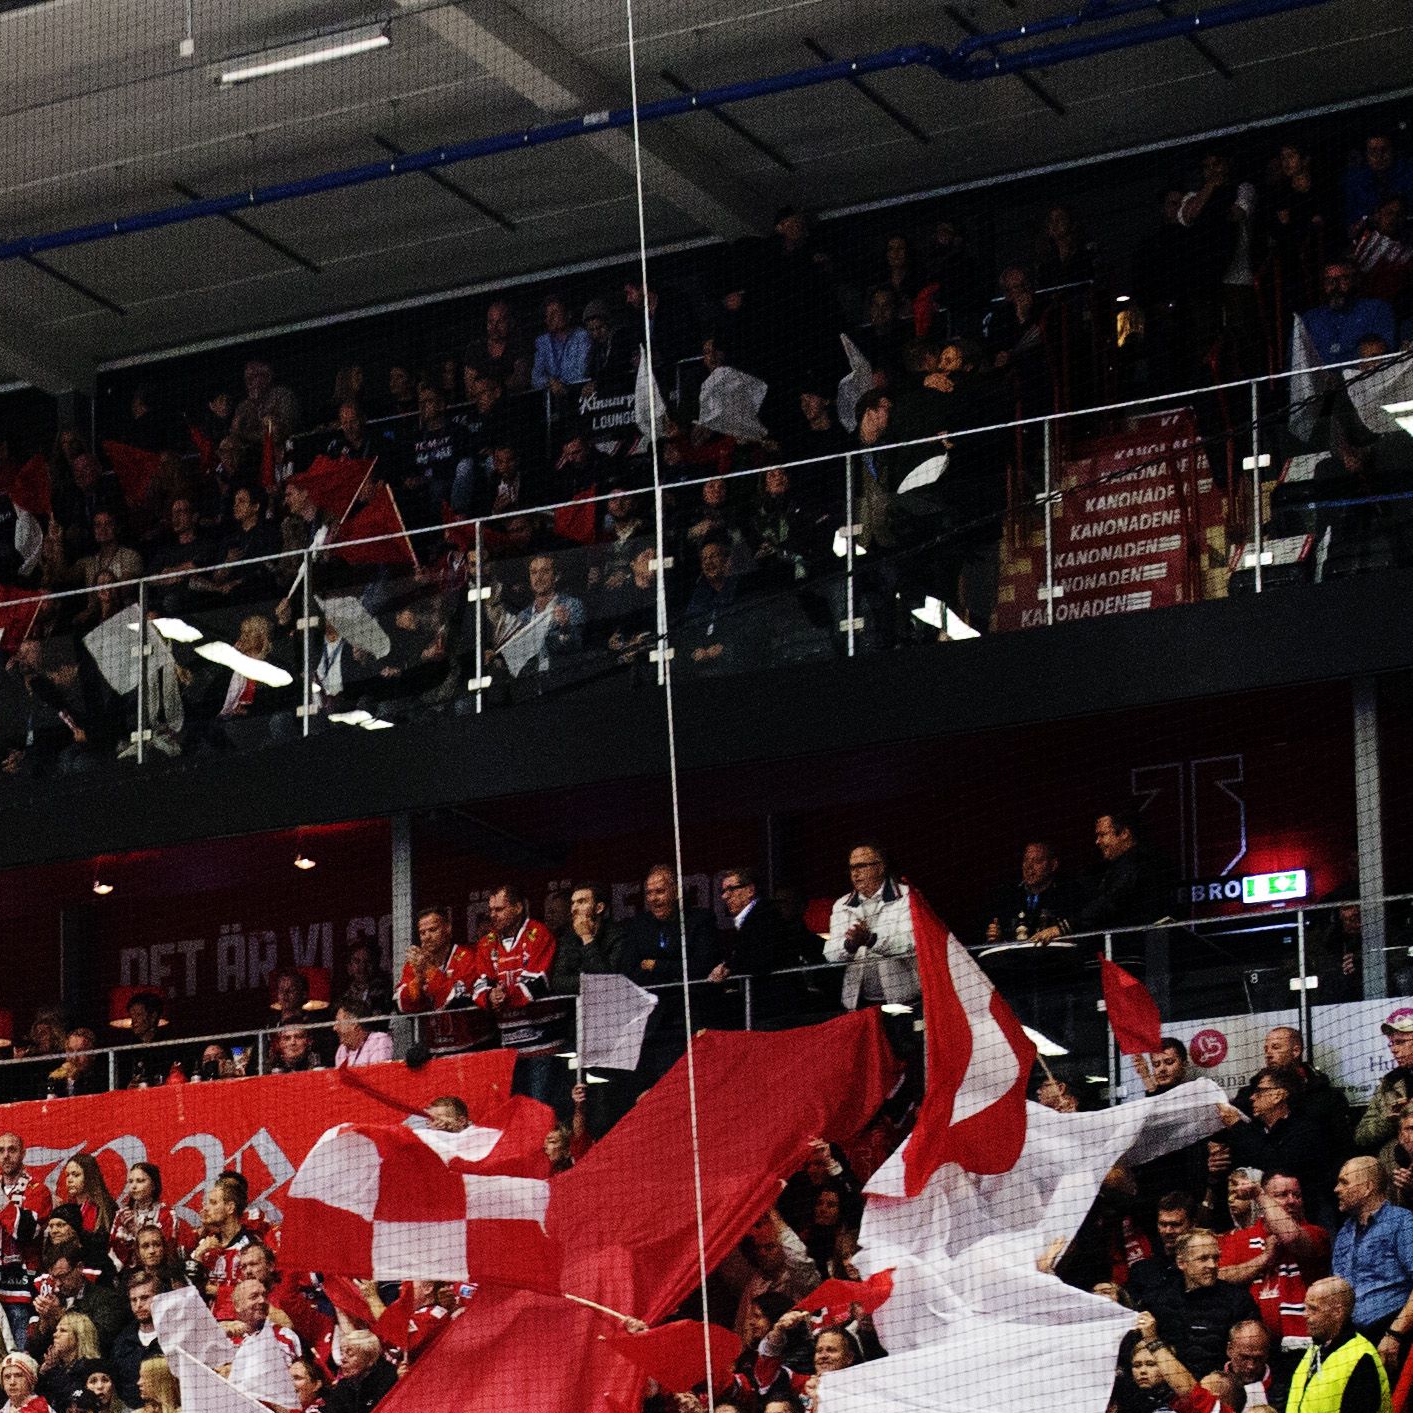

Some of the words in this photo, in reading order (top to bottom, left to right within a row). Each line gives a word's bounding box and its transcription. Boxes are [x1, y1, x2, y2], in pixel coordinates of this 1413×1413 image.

[1069, 510, 1175, 542] KANONADEN
[1054, 540, 1159, 570] KANONADEN
[119, 938, 205, 998] DET
[289, 921, 334, 970] VI
